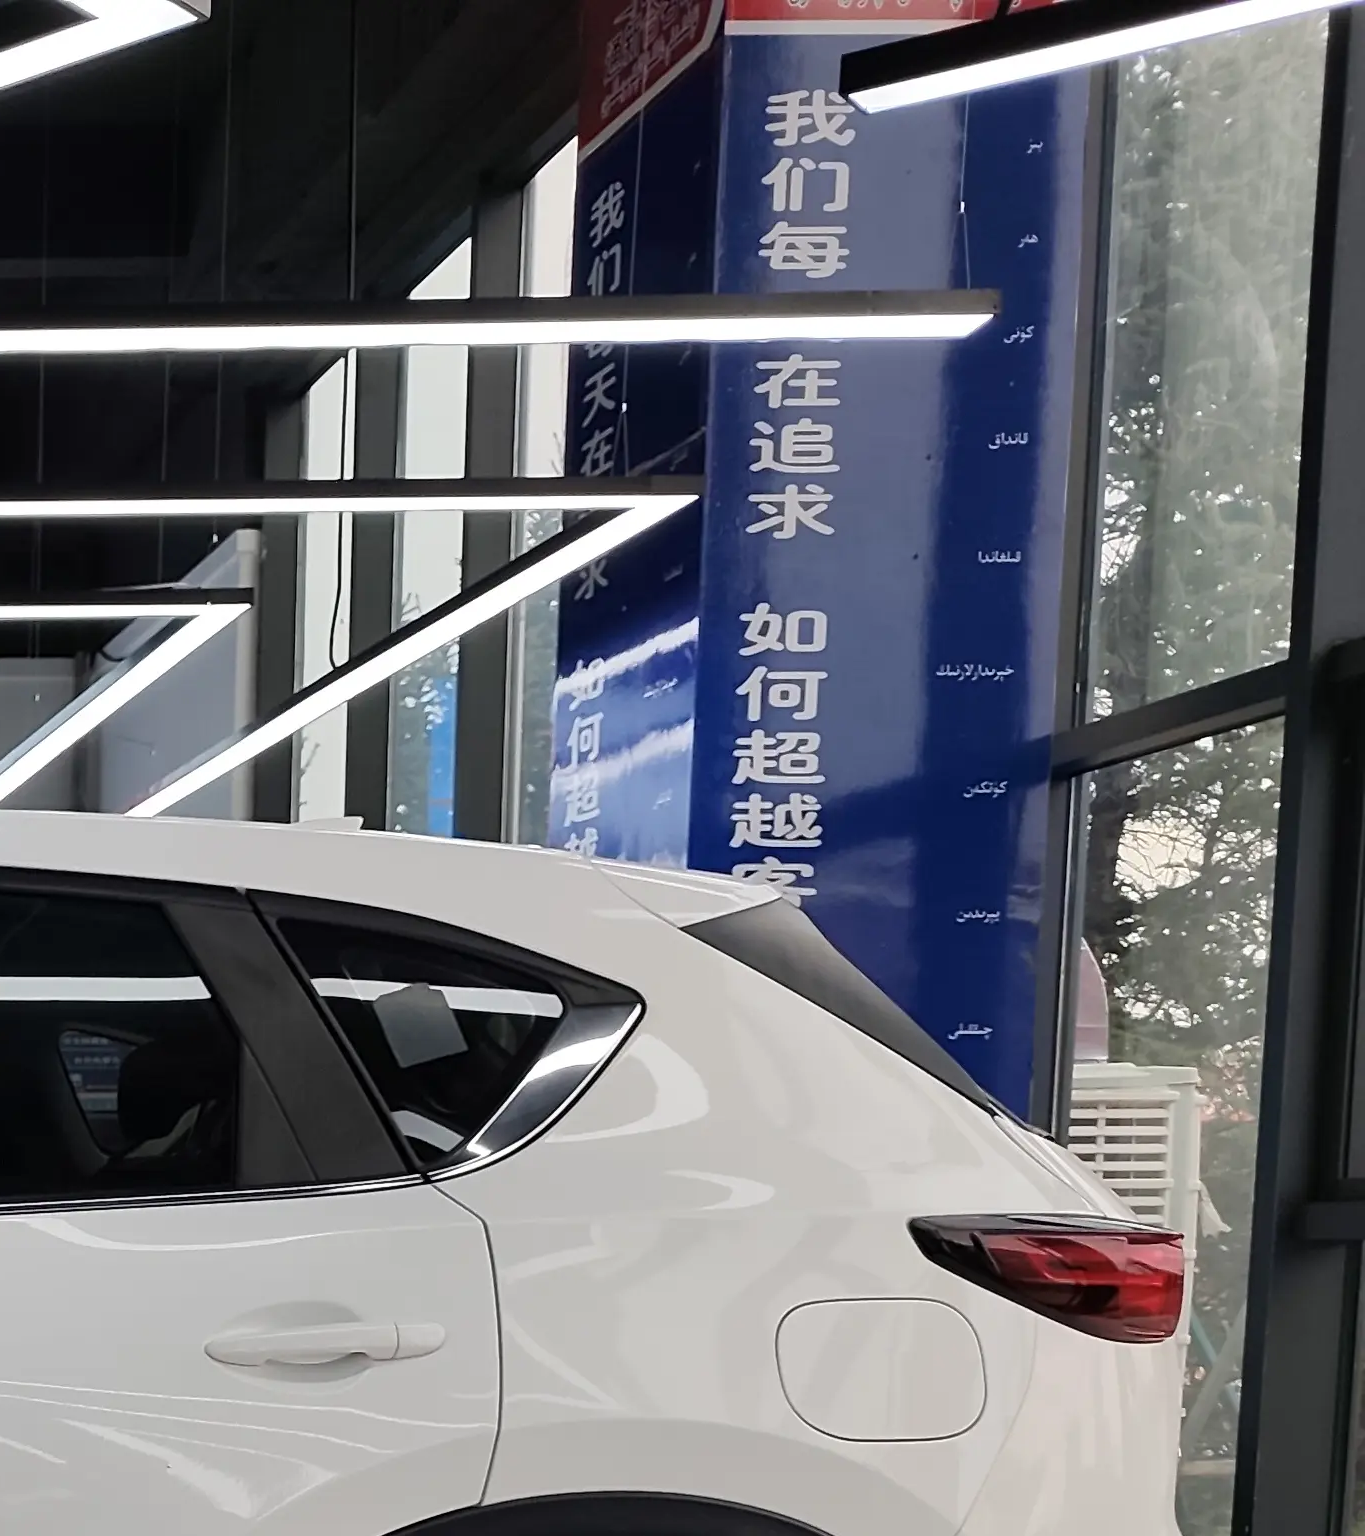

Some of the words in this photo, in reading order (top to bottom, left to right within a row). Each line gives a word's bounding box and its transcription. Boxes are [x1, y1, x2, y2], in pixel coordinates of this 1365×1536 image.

[573, 181, 625, 601] 我们天在求
[745, 88, 856, 541] 我们每在追求
